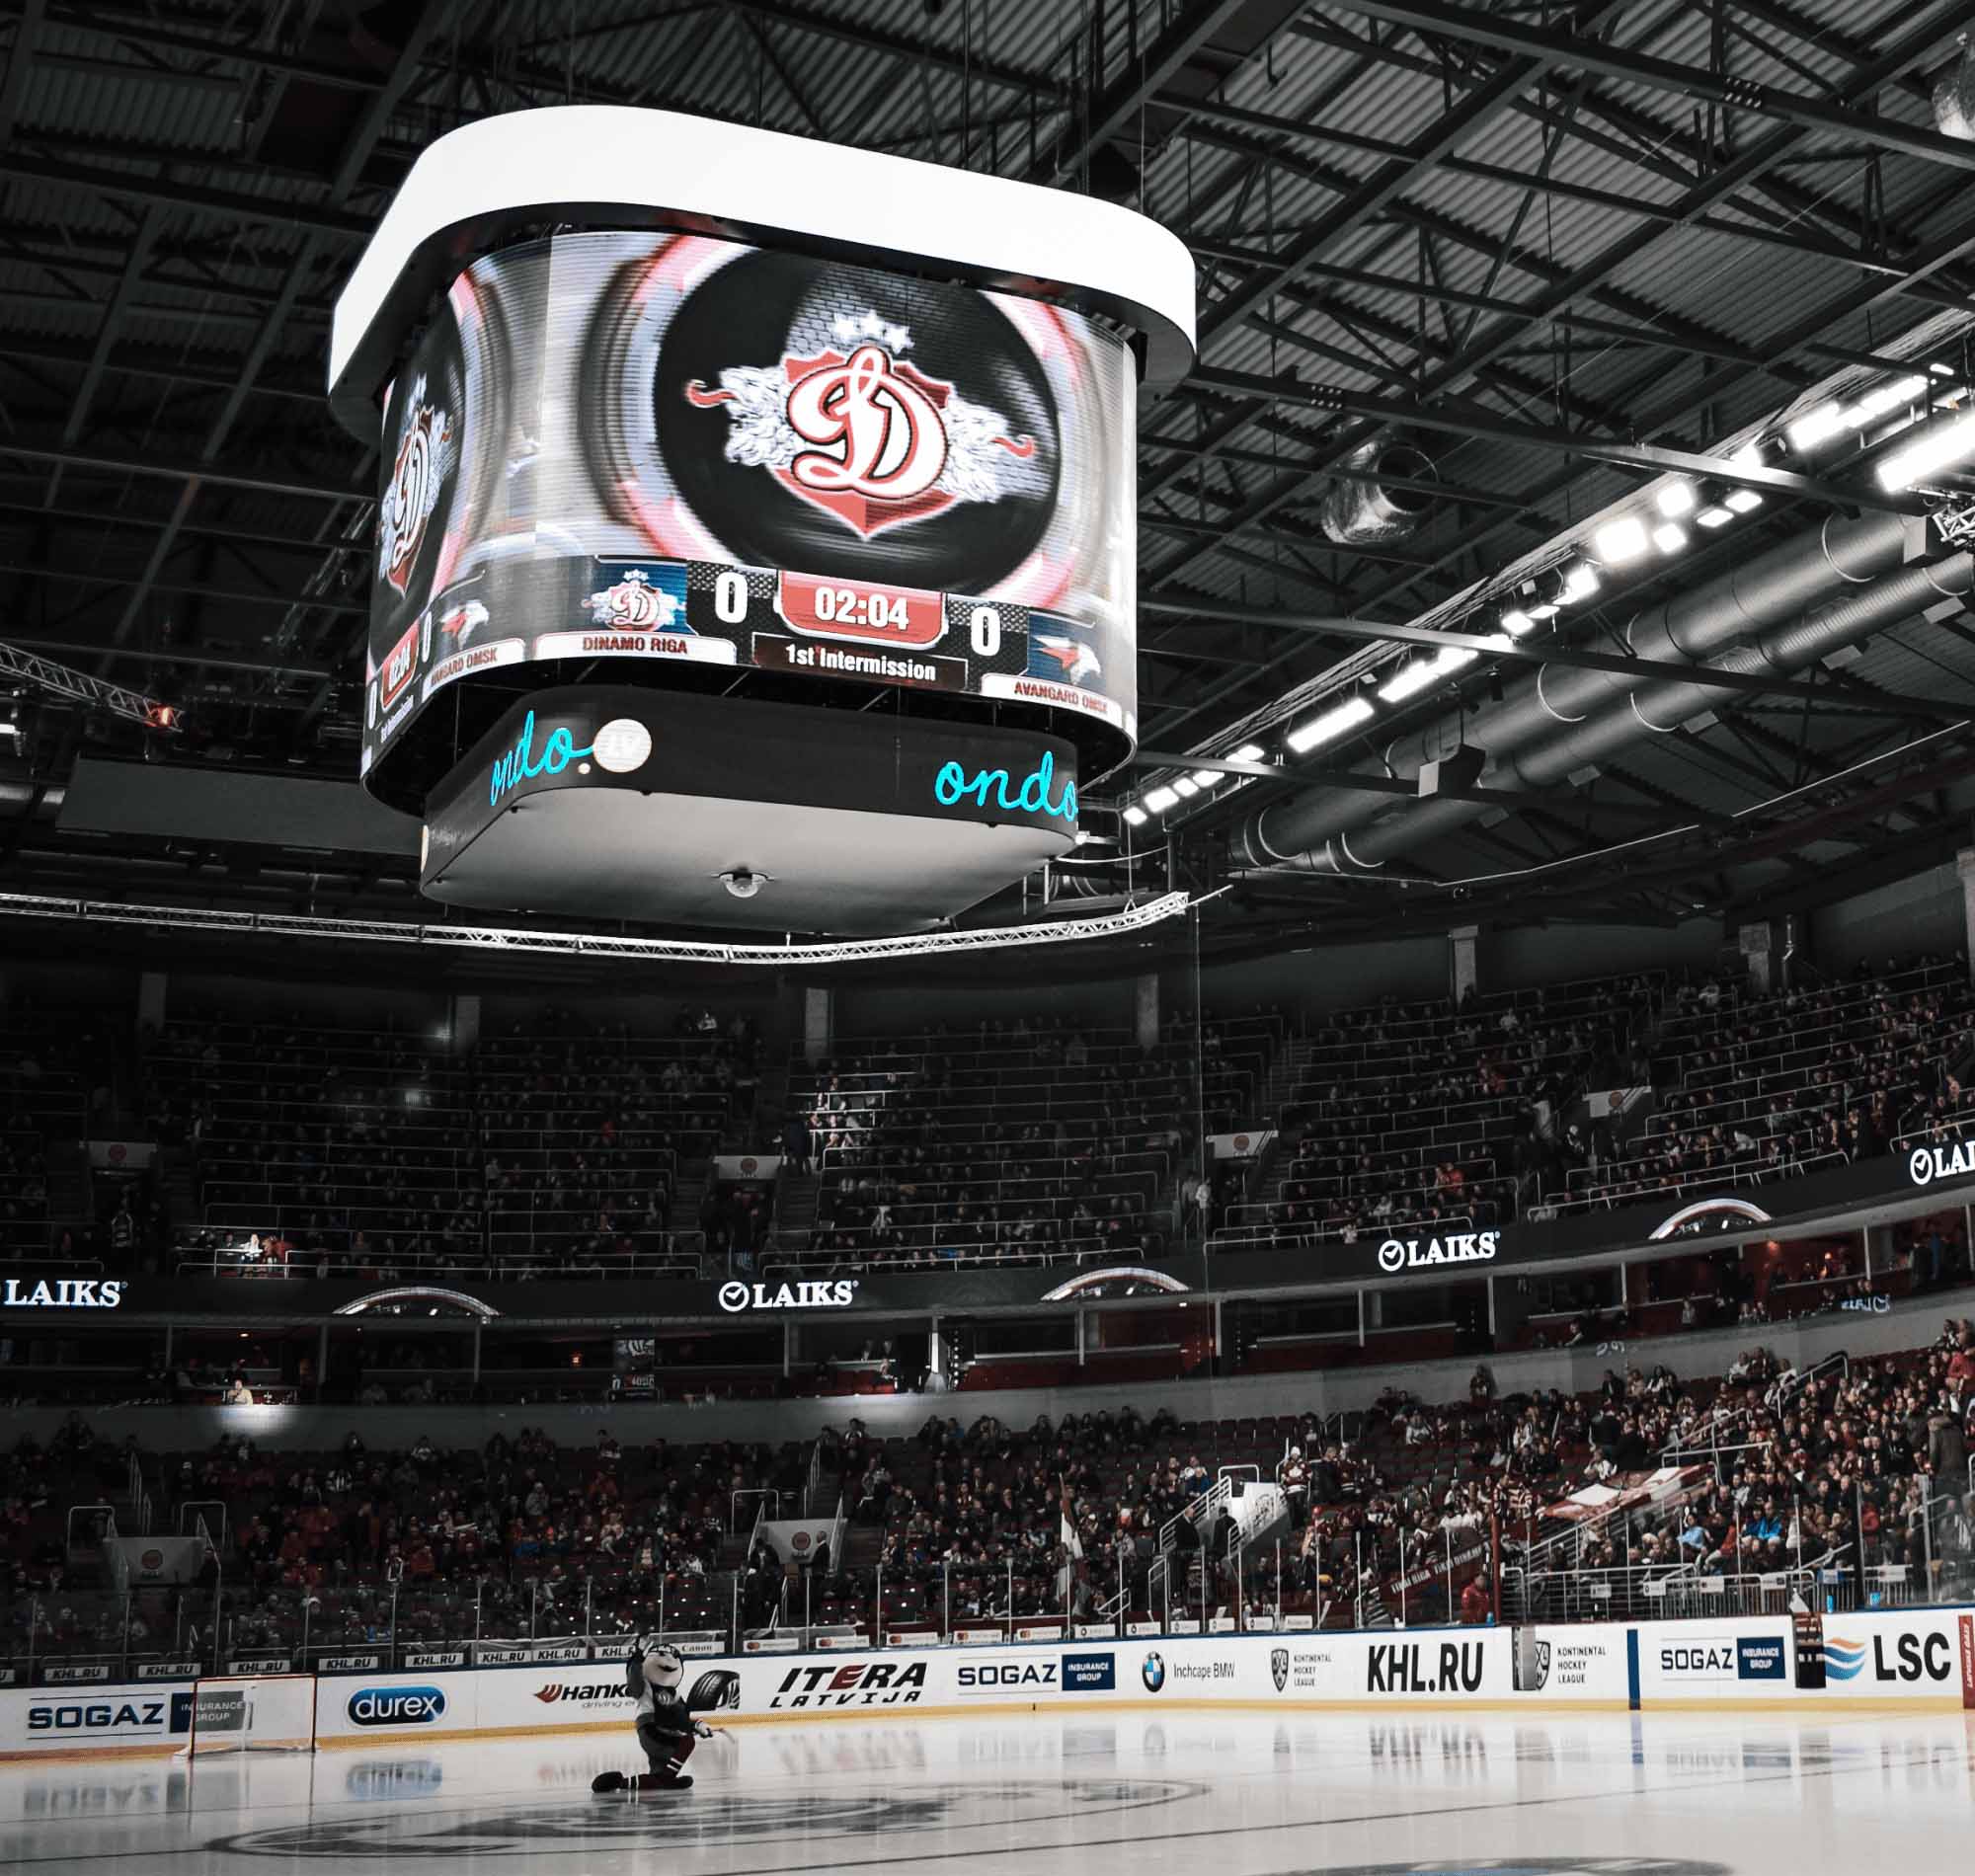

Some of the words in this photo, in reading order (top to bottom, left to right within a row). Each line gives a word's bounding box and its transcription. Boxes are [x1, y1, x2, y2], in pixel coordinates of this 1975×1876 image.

[715, 572, 748, 623] 0
[814, 587, 909, 631] 02:04
[971, 606, 1000, 656] 0
[583, 636, 645, 652] DINAMO
[650, 638, 687, 654] RIGA
[786, 644, 815, 665] 1st
[820, 647, 936, 681] Intermission
[1407, 1232, 1496, 1267] LAIKS
[4, 1279, 120, 1307] LAIKS
[752, 1280, 853, 1308] LAIKS
[413, 1654, 456, 1666] KHL.RU
[482, 1652, 525, 1663] KHL.RU
[537, 1648, 580, 1660] KHL.RU
[601, 1646, 635, 1657] KHL.R
[1557, 1645, 1606, 1657] KONTINENTAL
[1661, 1648, 1734, 1671] SOGAZ
[1873, 1631, 1951, 1681] LSC
[147, 1665, 194, 1677] KHL.RU
[238, 1661, 282, 1673] KHL.RU
[326, 1657, 371, 1669] KHL.RU
[1067, 1661, 1109, 1672] INSURANCE
[1173, 1662, 1211, 1680] Inchcape
[1214, 1662, 1234, 1678] BMW
[1368, 1641, 1483, 1692] KHL.RU
[1557, 1659, 1587, 1671] HOCKEY
[1750, 1659, 1773, 1669] GROUP
[778, 1662, 927, 1693] ITERA
[958, 1663, 1058, 1687] SOGAZ
[1076, 1672, 1102, 1681] GROUP
[1557, 1673, 1586, 1684] LEAGUE
[181, 1700, 245, 1711] INURANCE
[355, 1691, 436, 1719] durex
[29, 1702, 165, 1730] SOGAZ
